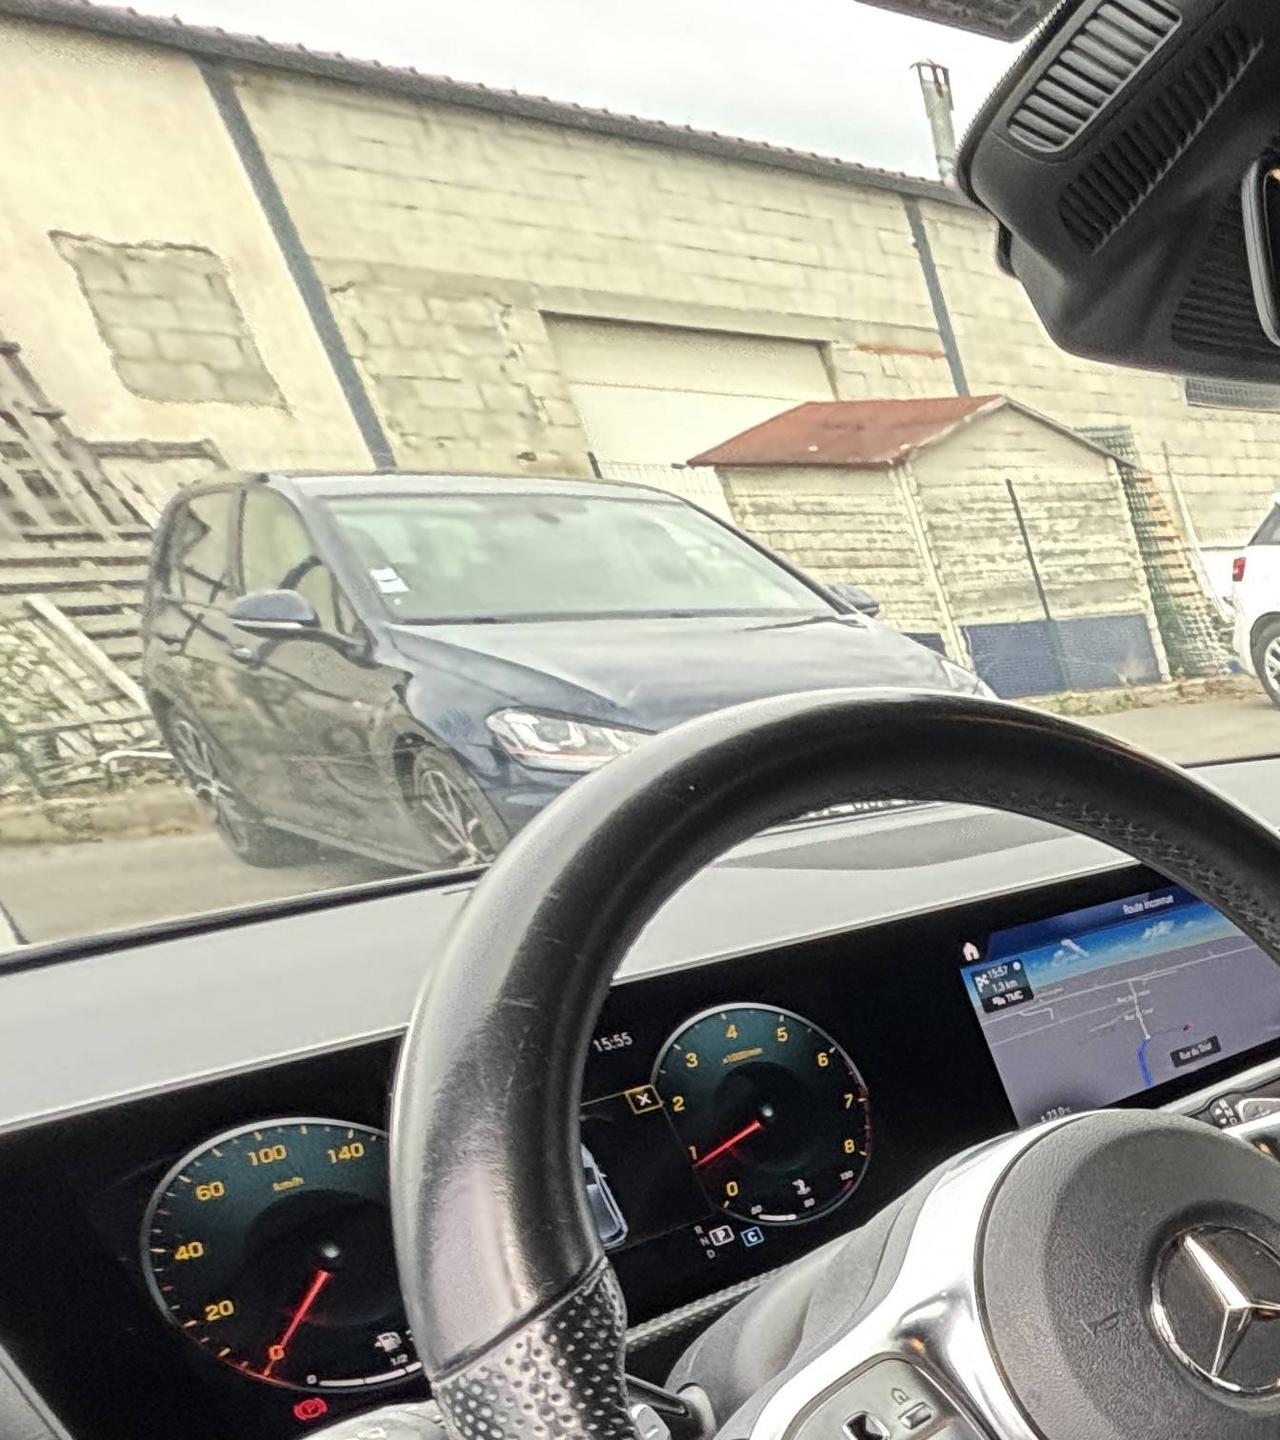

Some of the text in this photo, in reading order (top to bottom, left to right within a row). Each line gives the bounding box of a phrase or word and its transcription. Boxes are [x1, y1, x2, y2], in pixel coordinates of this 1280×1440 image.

[725, 1025, 738, 1039] 4
[776, 1027, 788, 1042] 5
[593, 1032, 633, 1052] 15:55
[685, 1052, 698, 1068] 3
[817, 1053, 829, 1067] 6
[672, 1096, 685, 1111] 2
[844, 1093, 854, 1109] 7
[327, 1142, 364, 1164] 140
[844, 1139, 855, 1153] 8
[247, 1144, 287, 1166] 100
[195, 1181, 225, 1201] 60
[726, 1181, 738, 1197] 0
[174, 1241, 204, 1261] 40
[205, 1300, 234, 1322] 20
